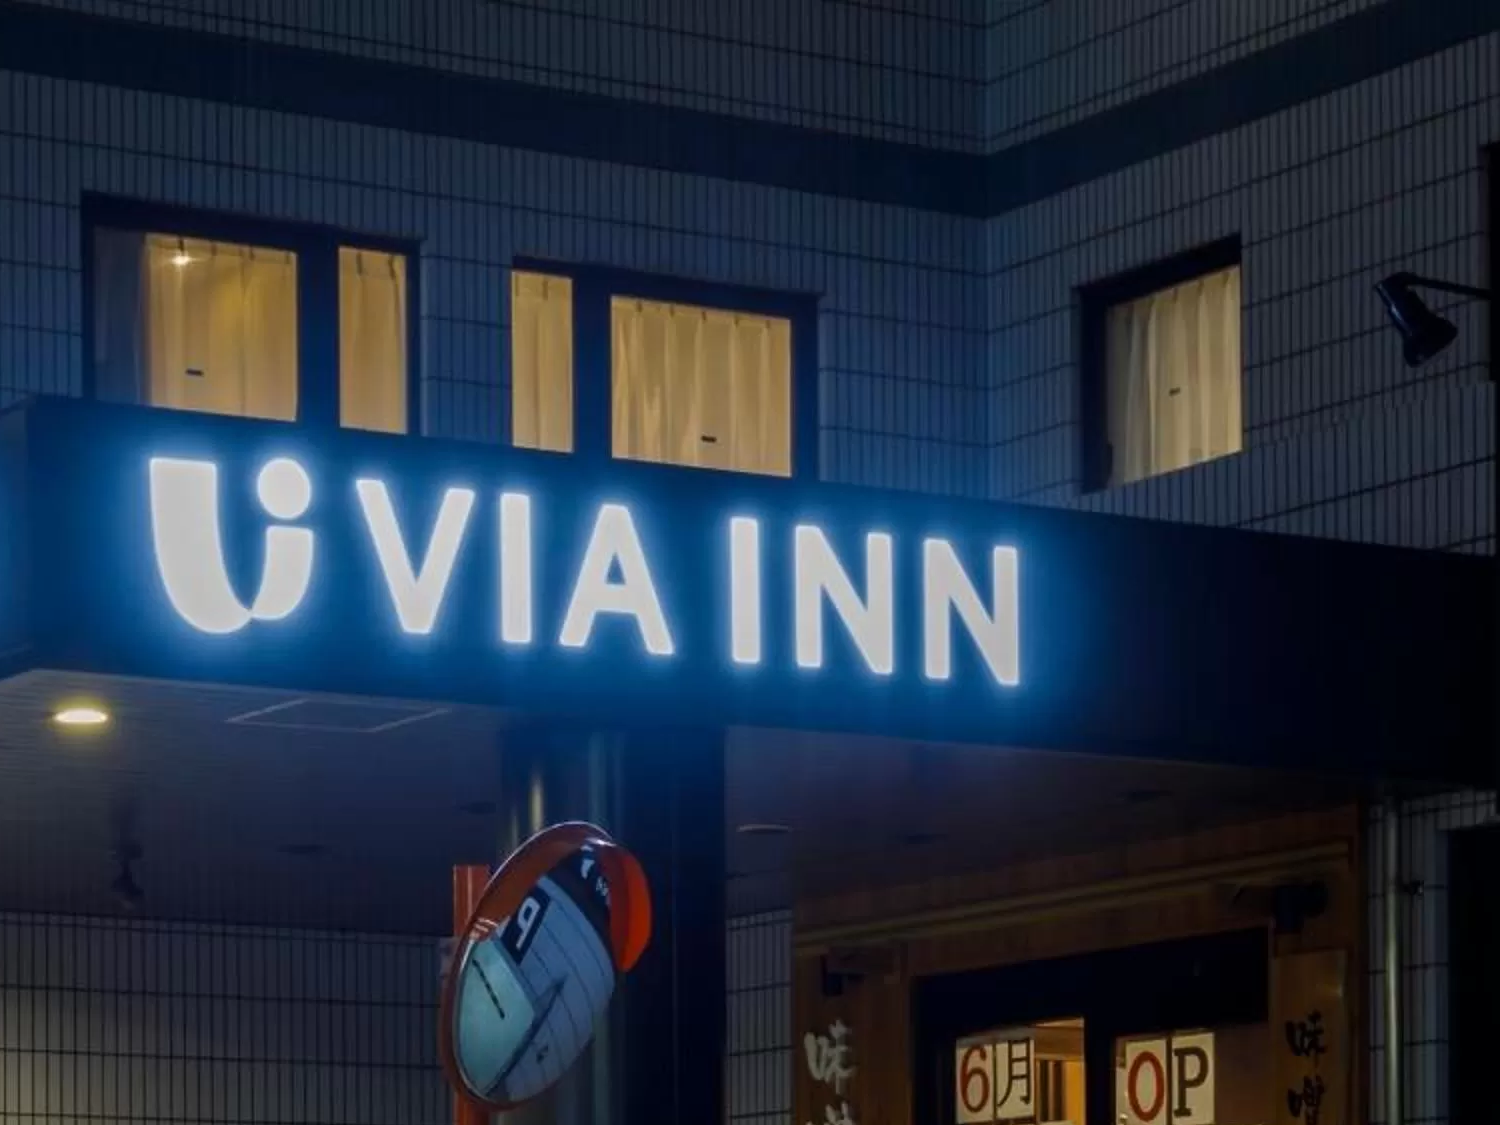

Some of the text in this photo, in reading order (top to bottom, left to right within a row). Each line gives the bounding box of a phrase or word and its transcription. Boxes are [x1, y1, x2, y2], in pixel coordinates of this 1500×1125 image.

[356, 478, 1020, 685] VIA INN
[959, 1038, 1032, 1113] 6月
